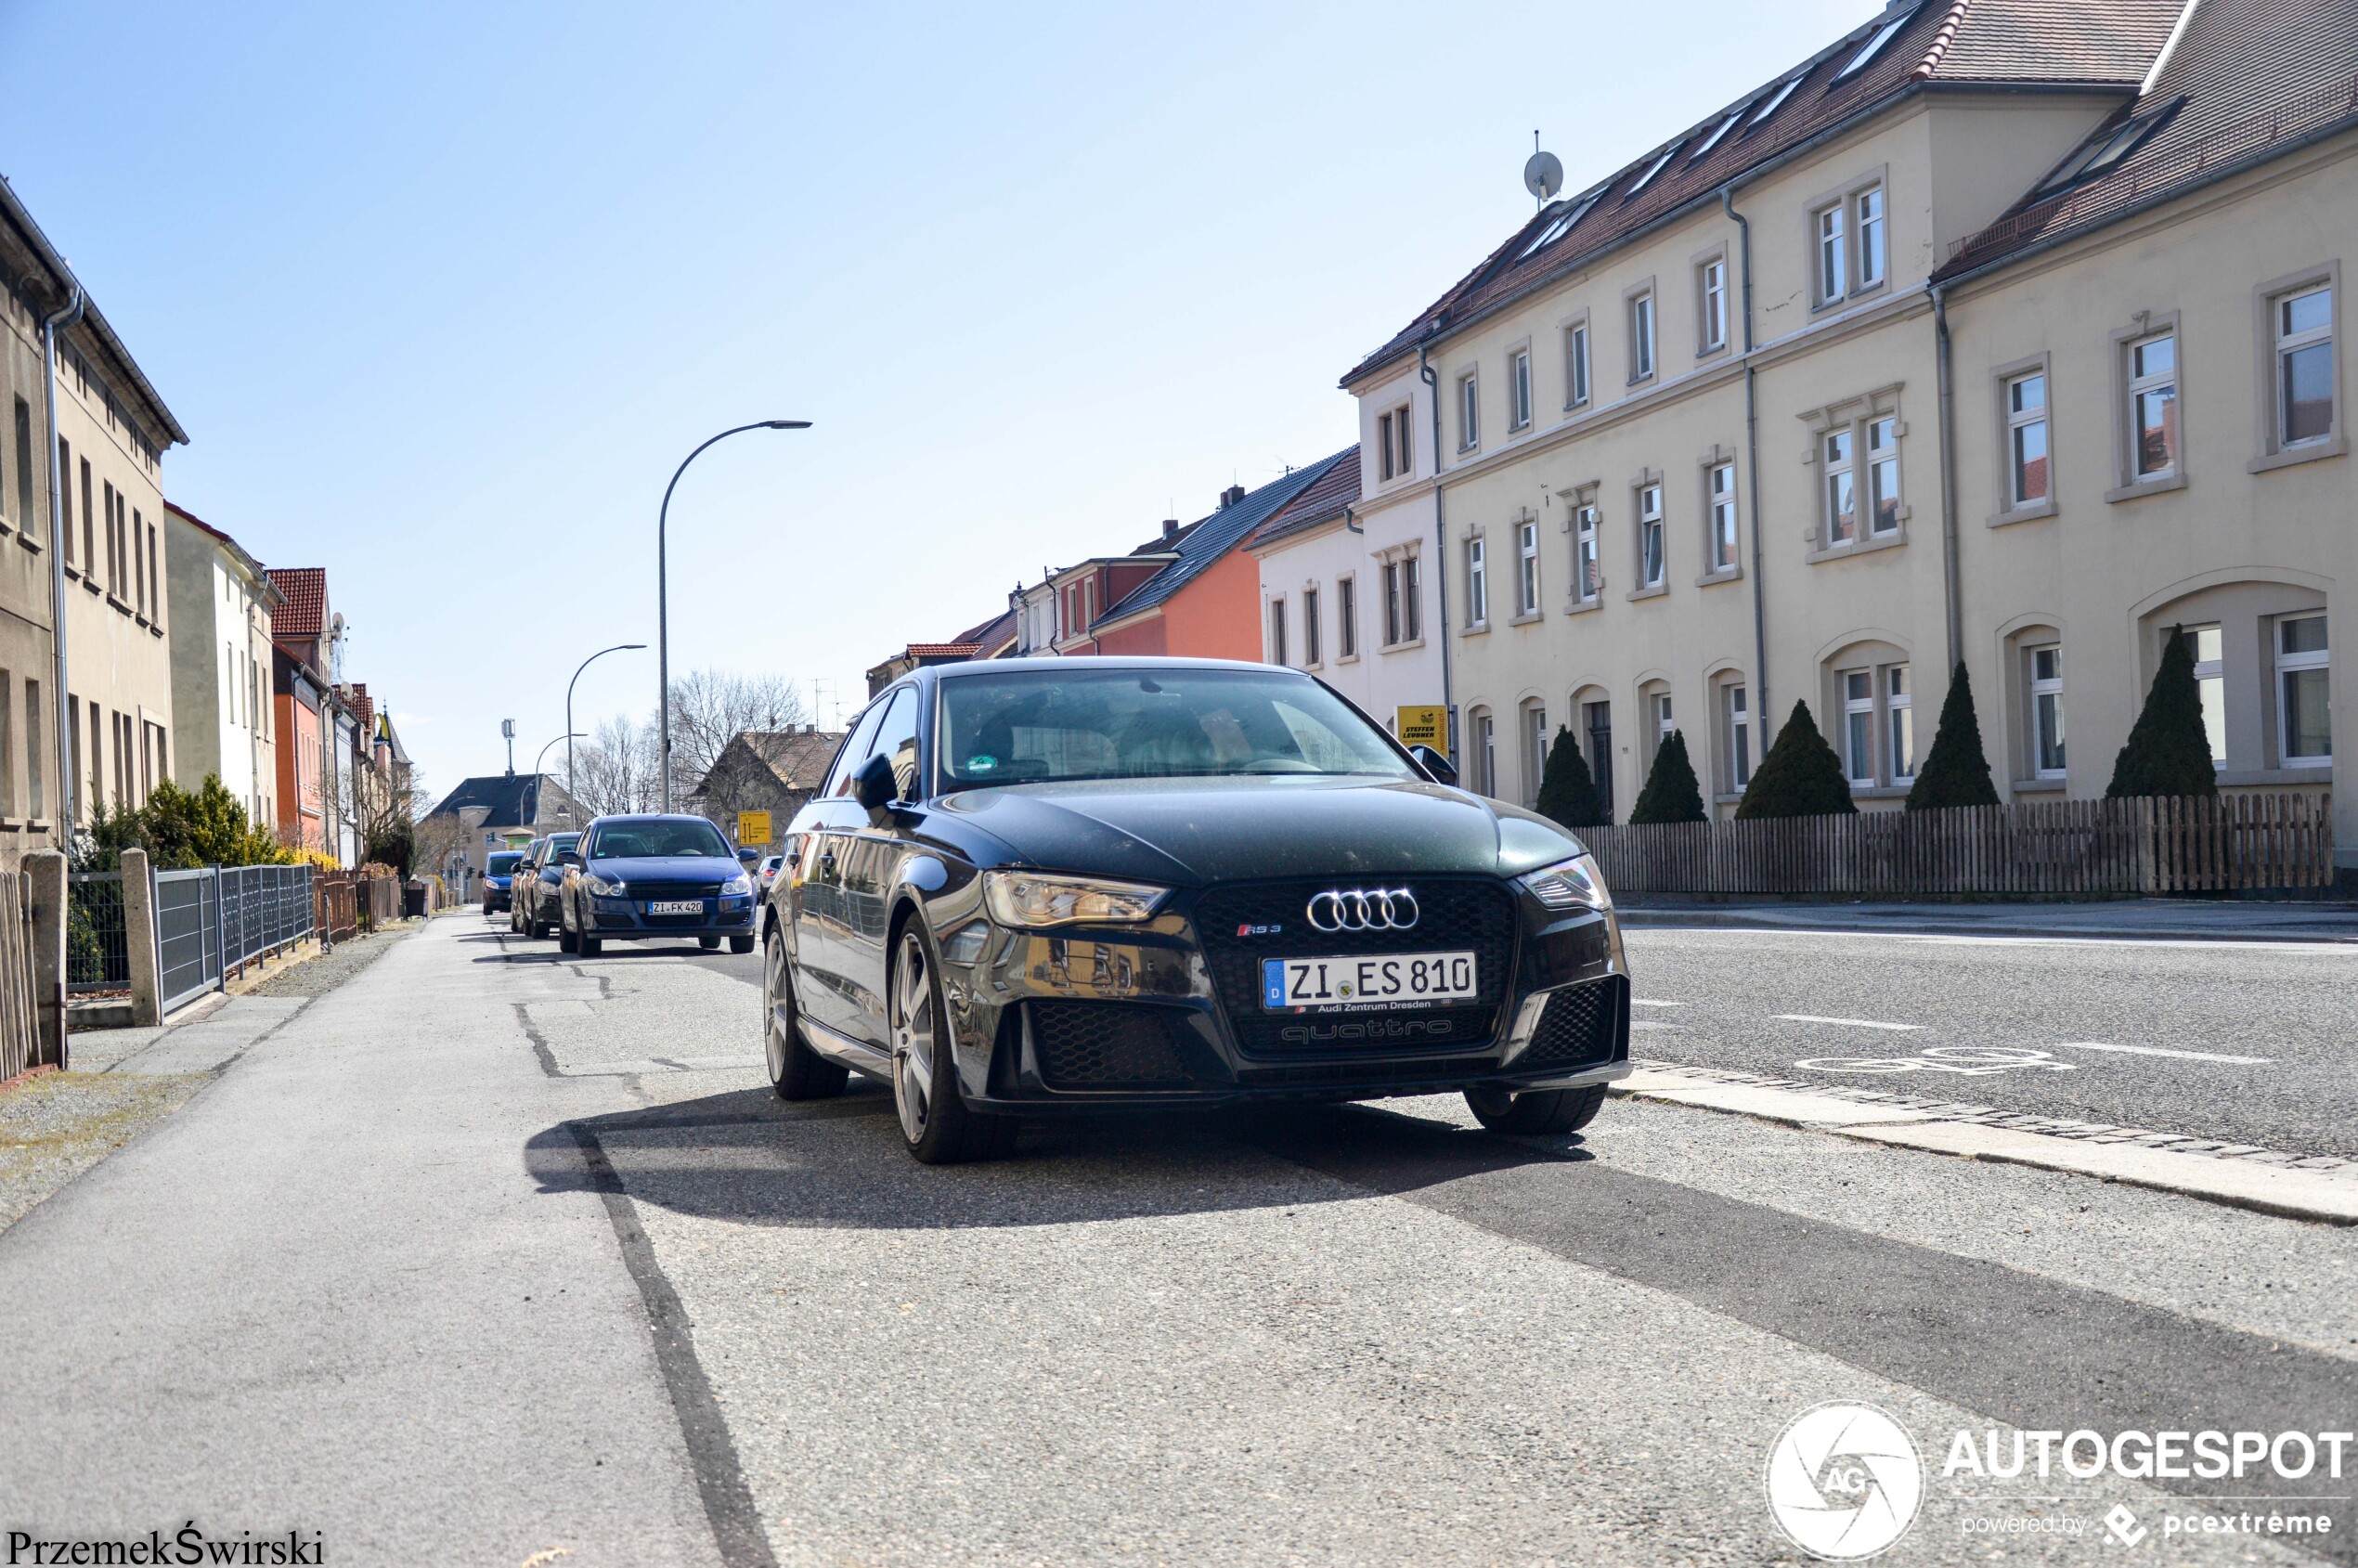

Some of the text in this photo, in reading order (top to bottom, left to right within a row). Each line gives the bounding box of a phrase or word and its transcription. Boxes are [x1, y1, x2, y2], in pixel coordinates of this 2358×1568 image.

[654, 902, 702, 912] ZI FK 420
[1289, 958, 1471, 1000] ZI ES 810
[1271, 988, 1279, 999] D
[1317, 1000, 1432, 1013] Audi Zentrum Dresden
[1282, 1019, 1452, 1045] quattro
